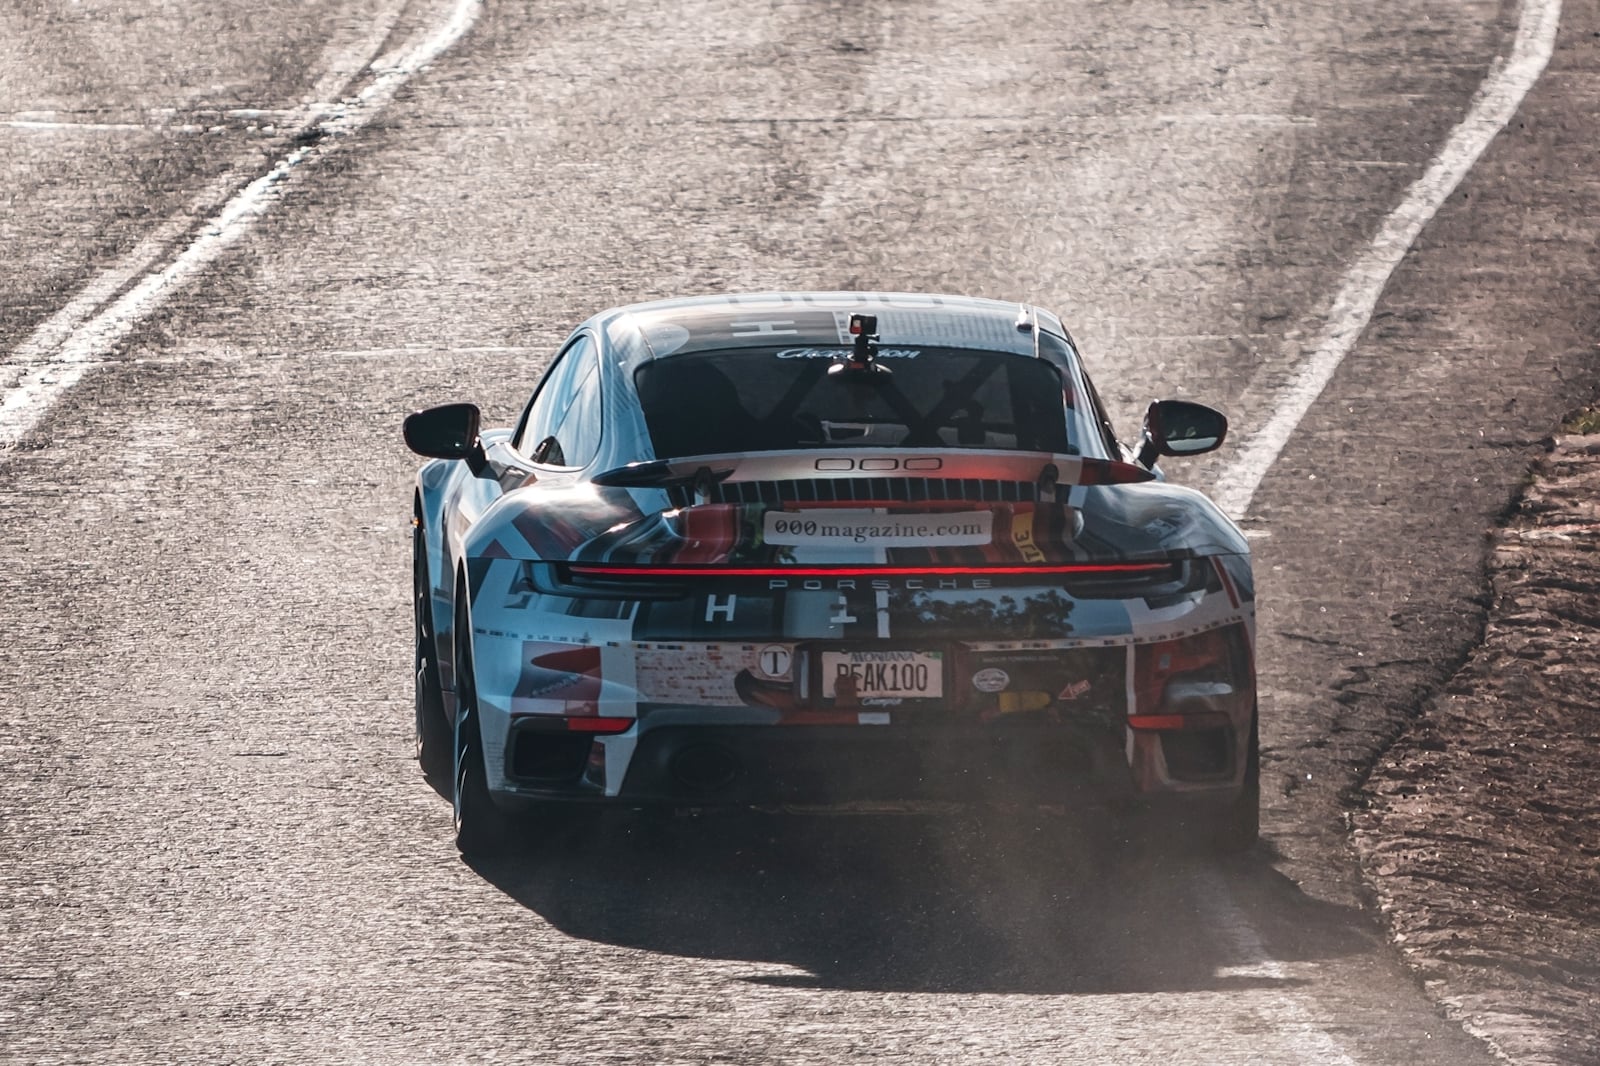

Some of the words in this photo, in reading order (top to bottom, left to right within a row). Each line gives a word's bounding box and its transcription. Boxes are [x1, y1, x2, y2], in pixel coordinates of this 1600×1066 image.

[774, 519, 983, 543] 000magazine.com
[769, 579, 992, 590] PORSCHE
[763, 651, 788, 675] T
